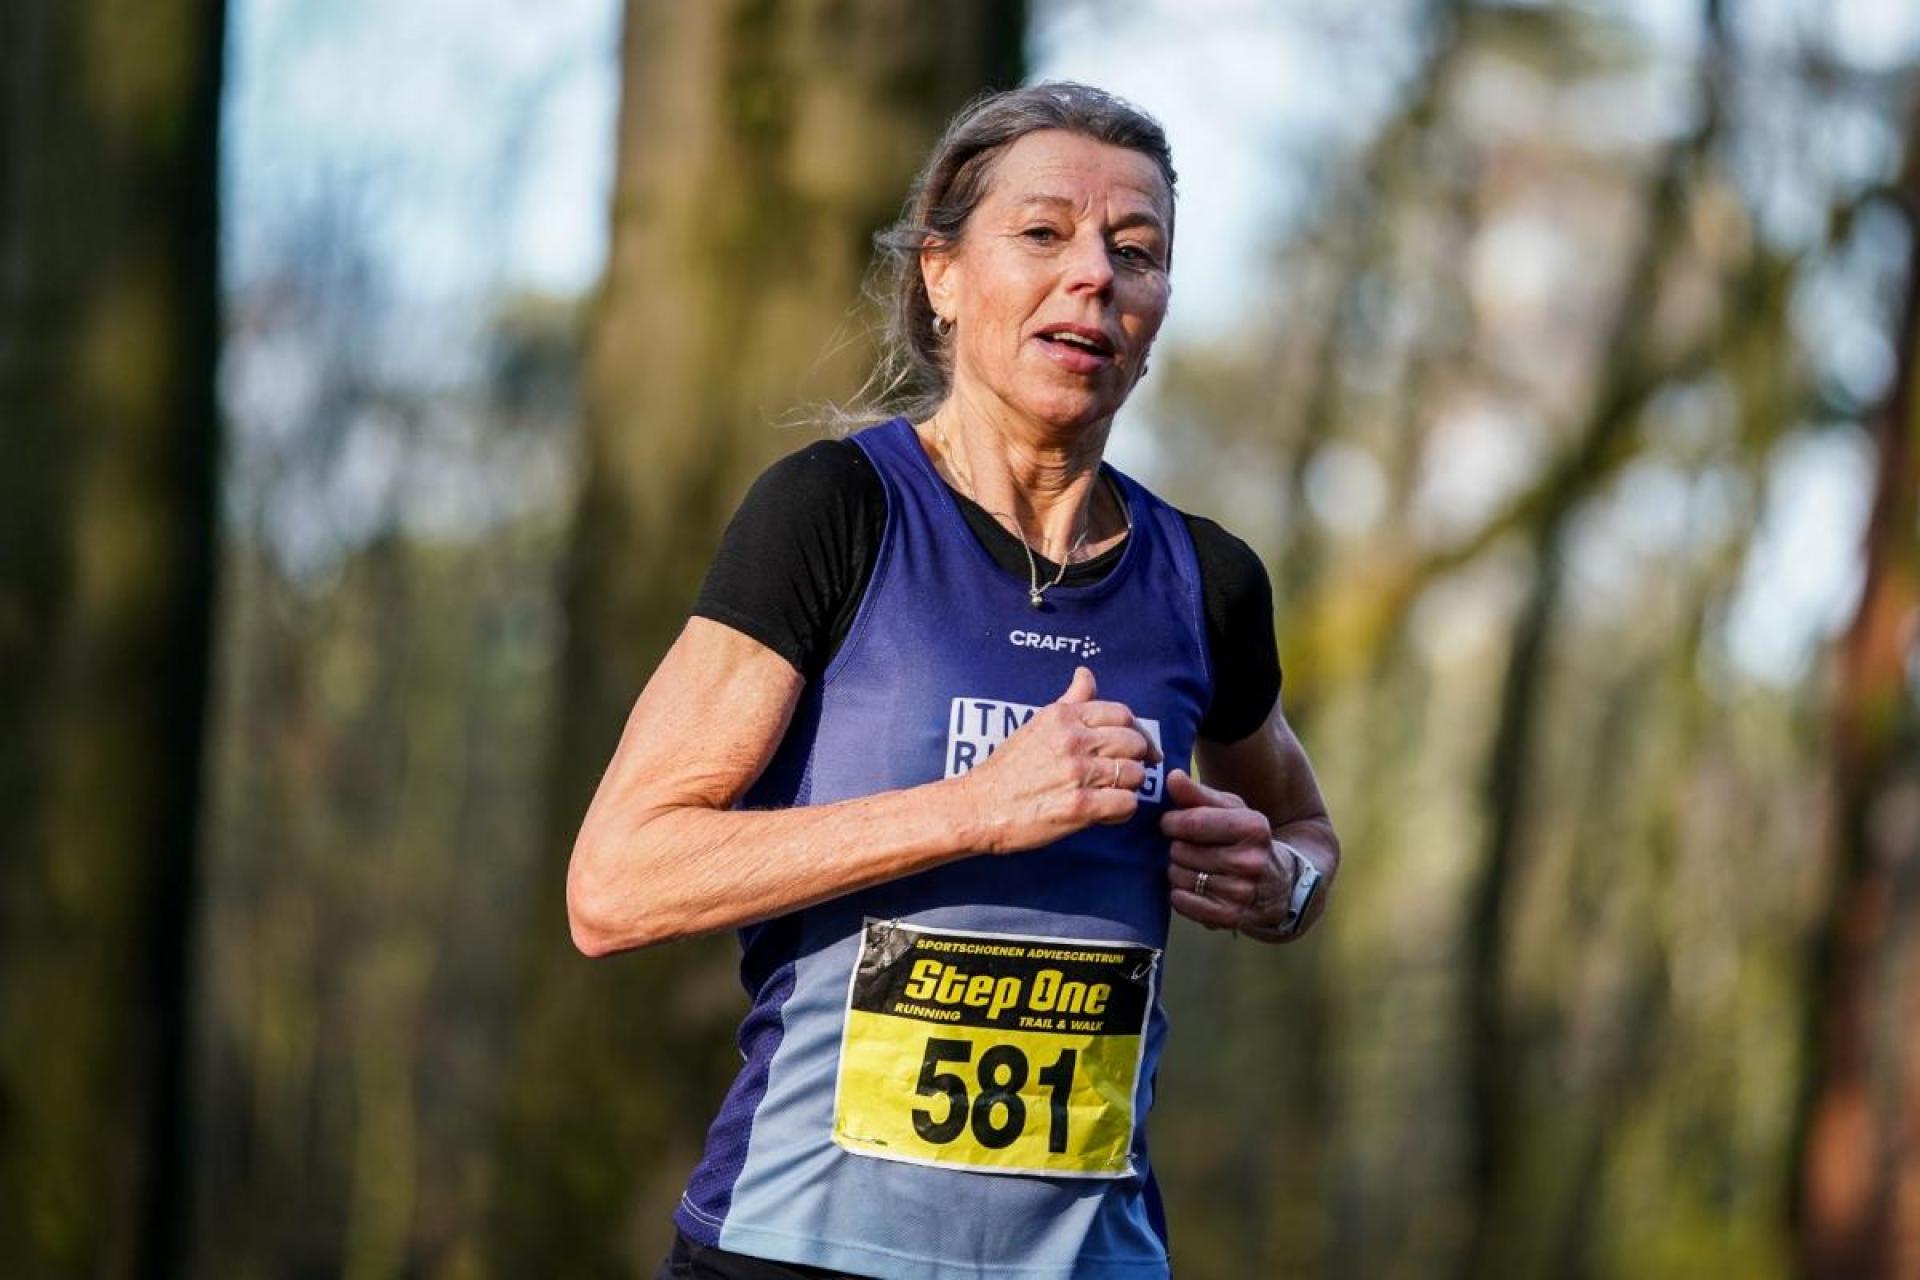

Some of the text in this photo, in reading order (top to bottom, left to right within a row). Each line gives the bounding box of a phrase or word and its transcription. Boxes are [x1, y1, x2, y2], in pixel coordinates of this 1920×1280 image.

[1009, 630, 1082, 654] CRAFT
[916, 939, 1024, 957] SPORTSCHOENEN
[904, 959, 1111, 1019] Step One
[894, 1002, 1104, 1032] RUNNING TRAIL & WALK
[911, 1036, 1077, 1154] 581
